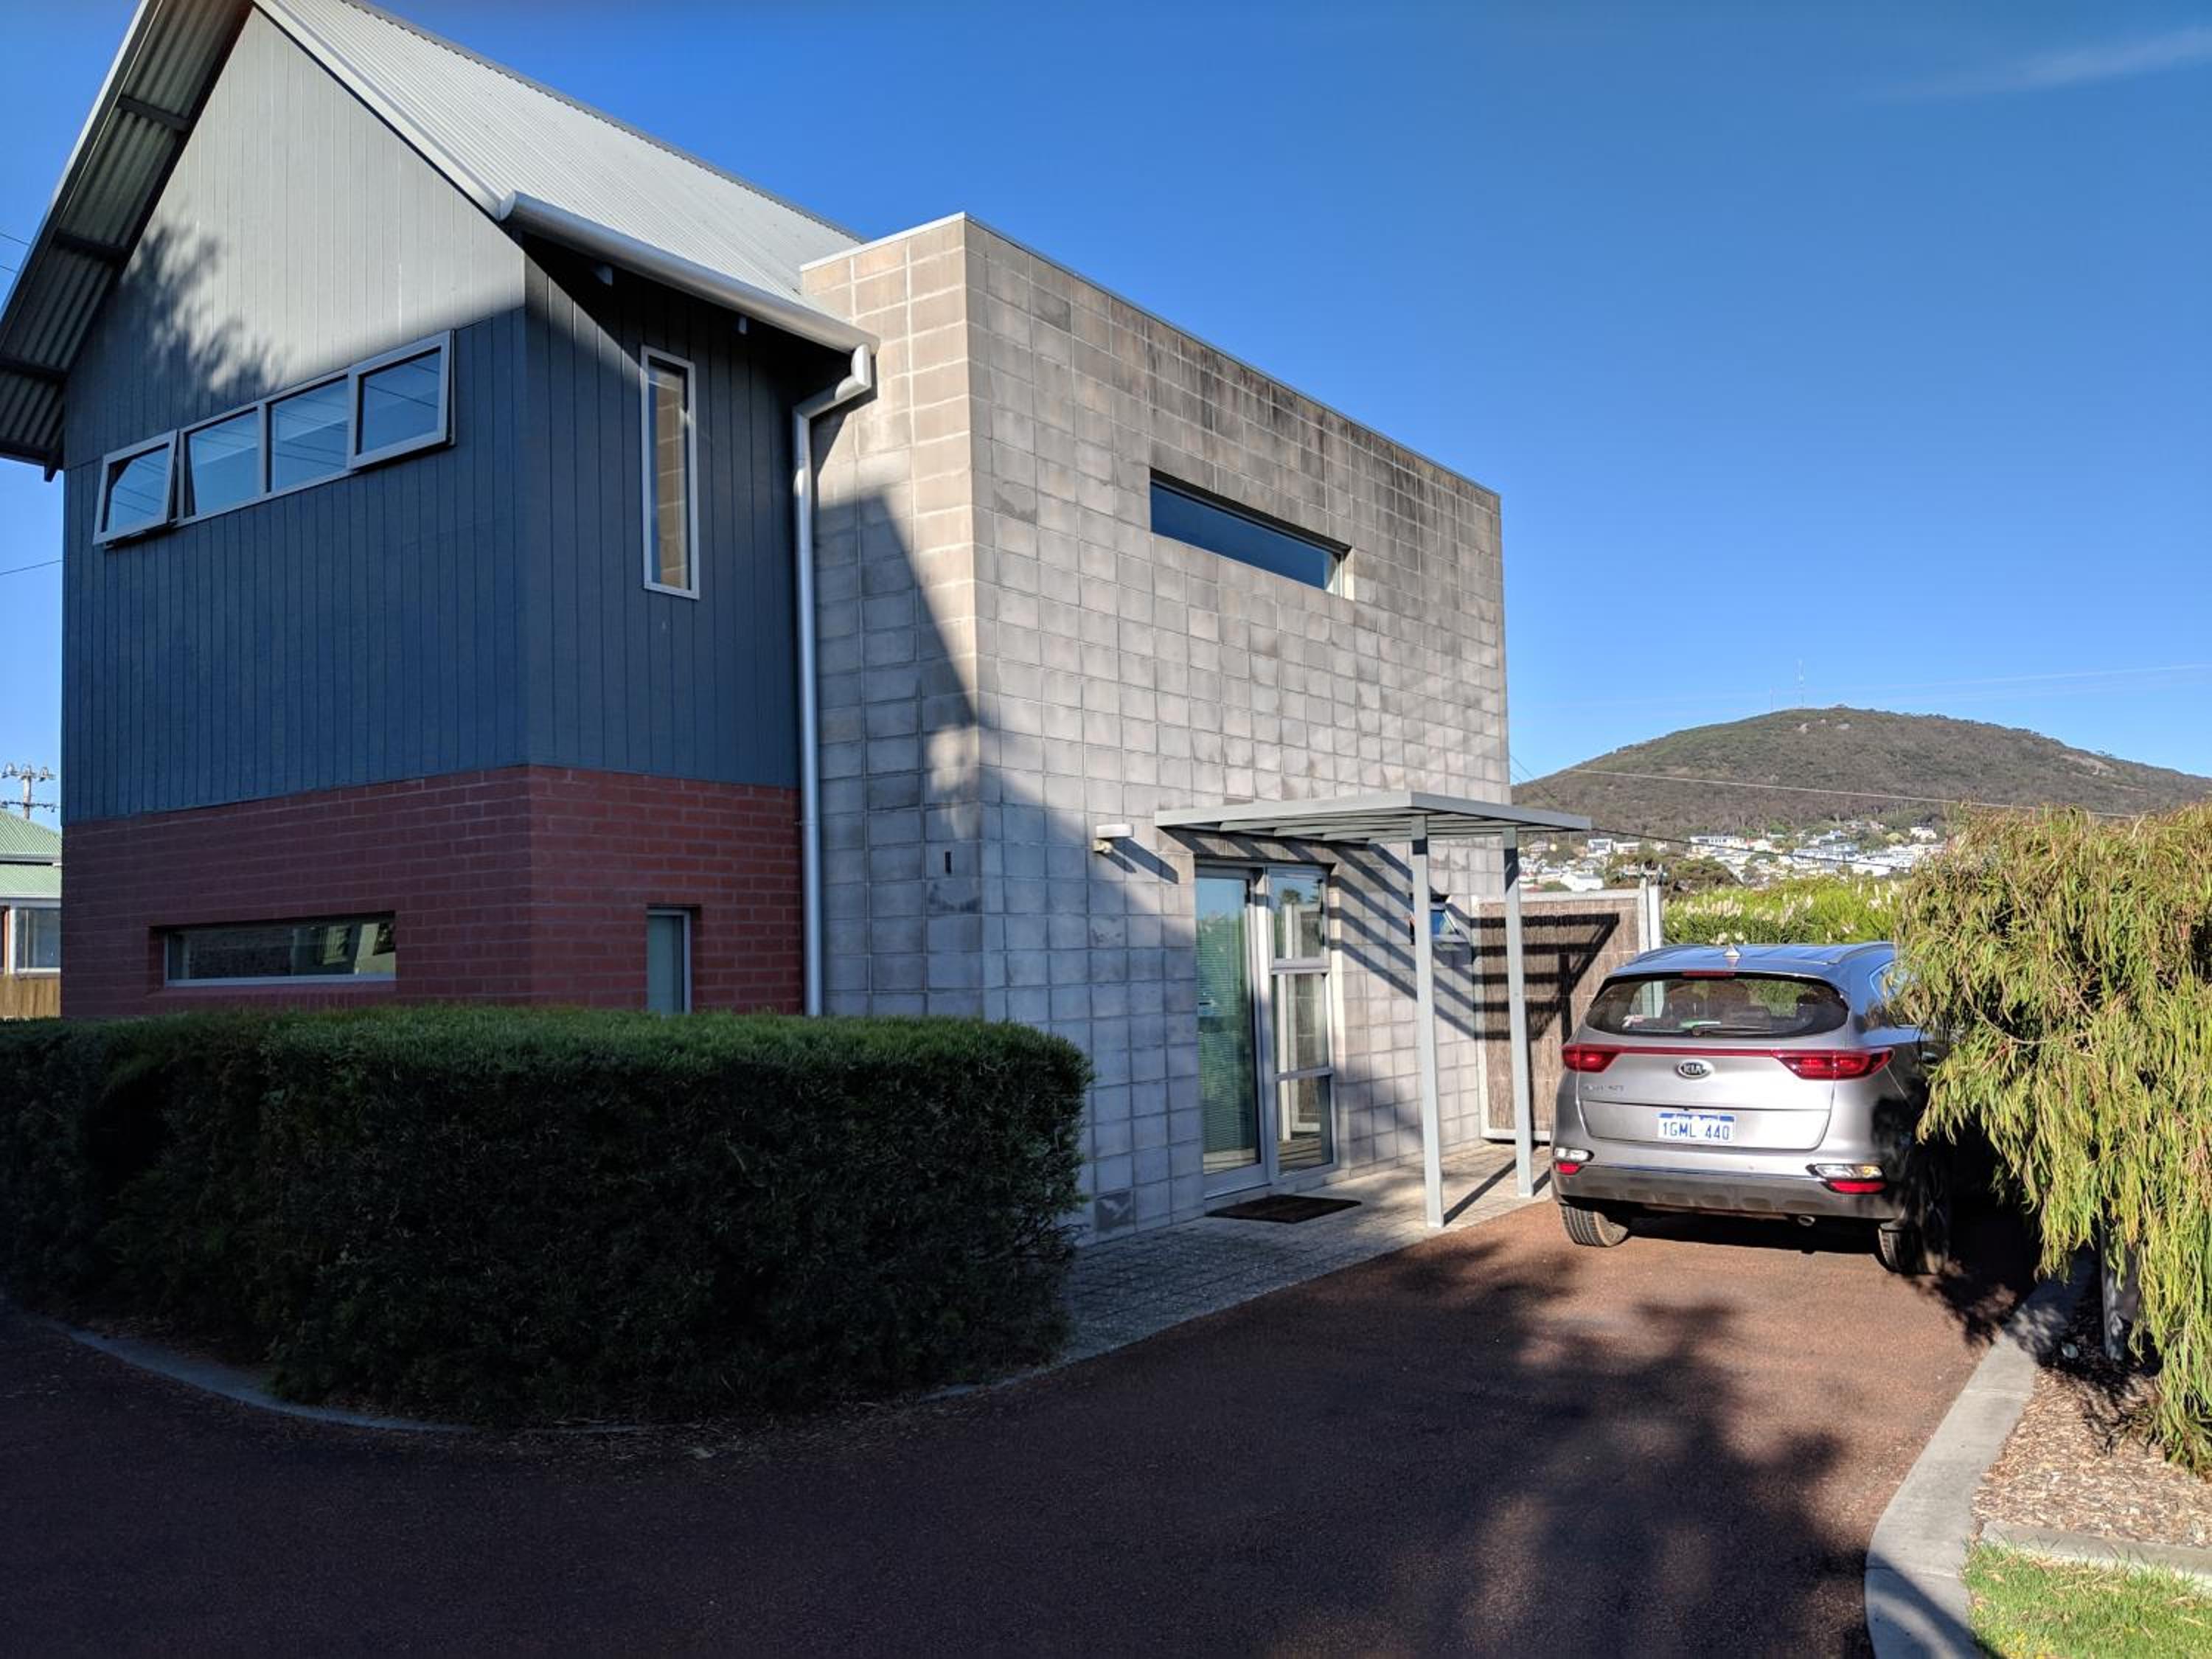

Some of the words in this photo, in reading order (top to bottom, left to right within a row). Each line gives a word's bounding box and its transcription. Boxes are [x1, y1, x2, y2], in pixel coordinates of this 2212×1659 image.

[1683, 1063, 1703, 1074] KIA
[1663, 1121, 1697, 1138] 1GML
[1705, 1124, 1731, 1141] 440
